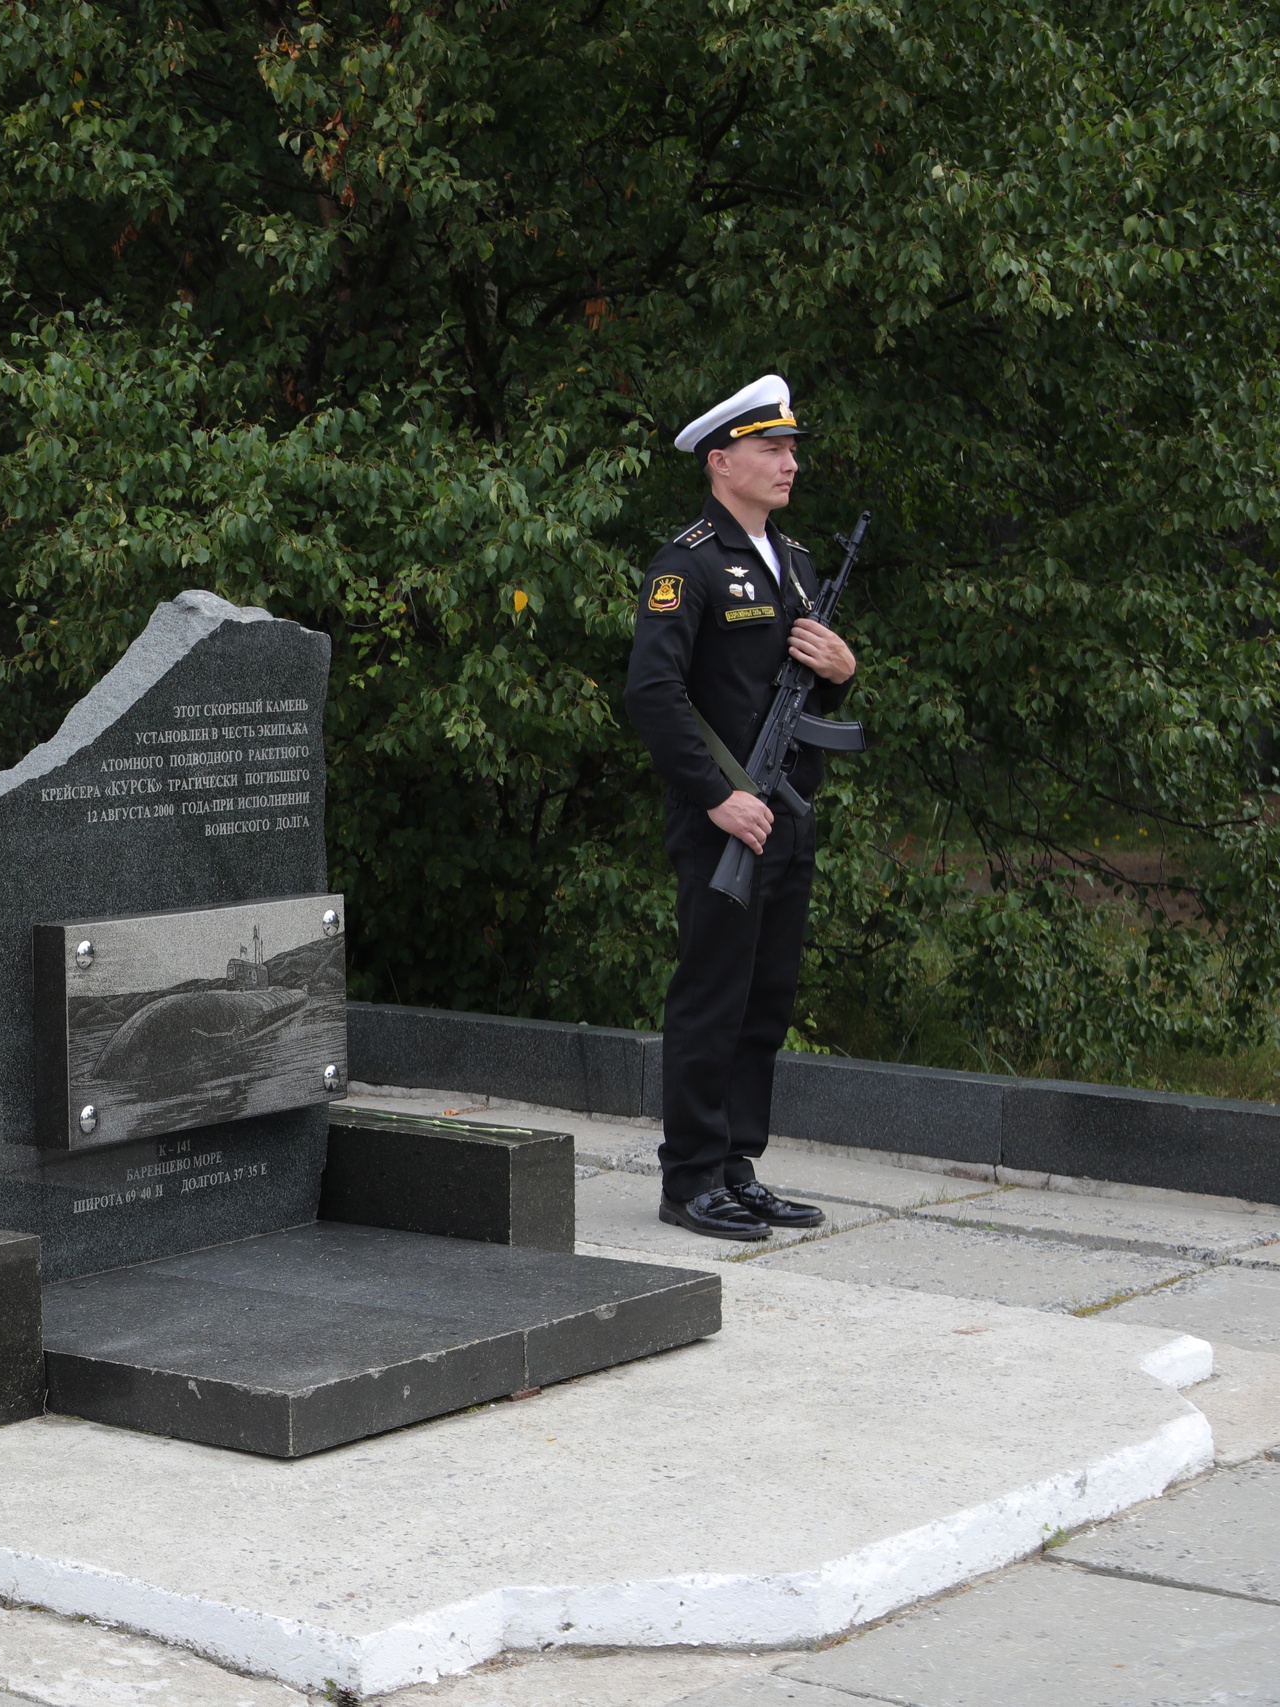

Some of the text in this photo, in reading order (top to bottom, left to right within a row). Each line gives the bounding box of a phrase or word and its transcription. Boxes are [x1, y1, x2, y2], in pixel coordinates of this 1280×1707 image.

[173, 699, 308, 718] ЭТОТ СКОРБНЫЙ КАМЕНЬ
[136, 723, 308, 745] УСТАНОВЛЕН В ЧЕСТЬ ЭКИПАЖА
[100, 746, 309, 772] АТОМНОГО ПОДВОДНОГО РАКЕТНОГО
[41, 770, 310, 802] КРЕЙСЕРА «КУРСК» ТРАГИЧЕСКИ ПОГИБШЕГО
[87, 792, 310, 823] 12 АВГУСТА 2000 ГОДА ПРИ ИСПОЛНЕНИИ
[205, 816, 309, 836] ВОИНСКОГО ДОЛГА
[177, 1141, 191, 1154] 141
[126, 1151, 222, 1181] БАРЕНЦЕВО МОРЕ
[73, 1194, 122, 1214] ШИРОТА
[181, 1171, 231, 1194] ДОЛГОТА
